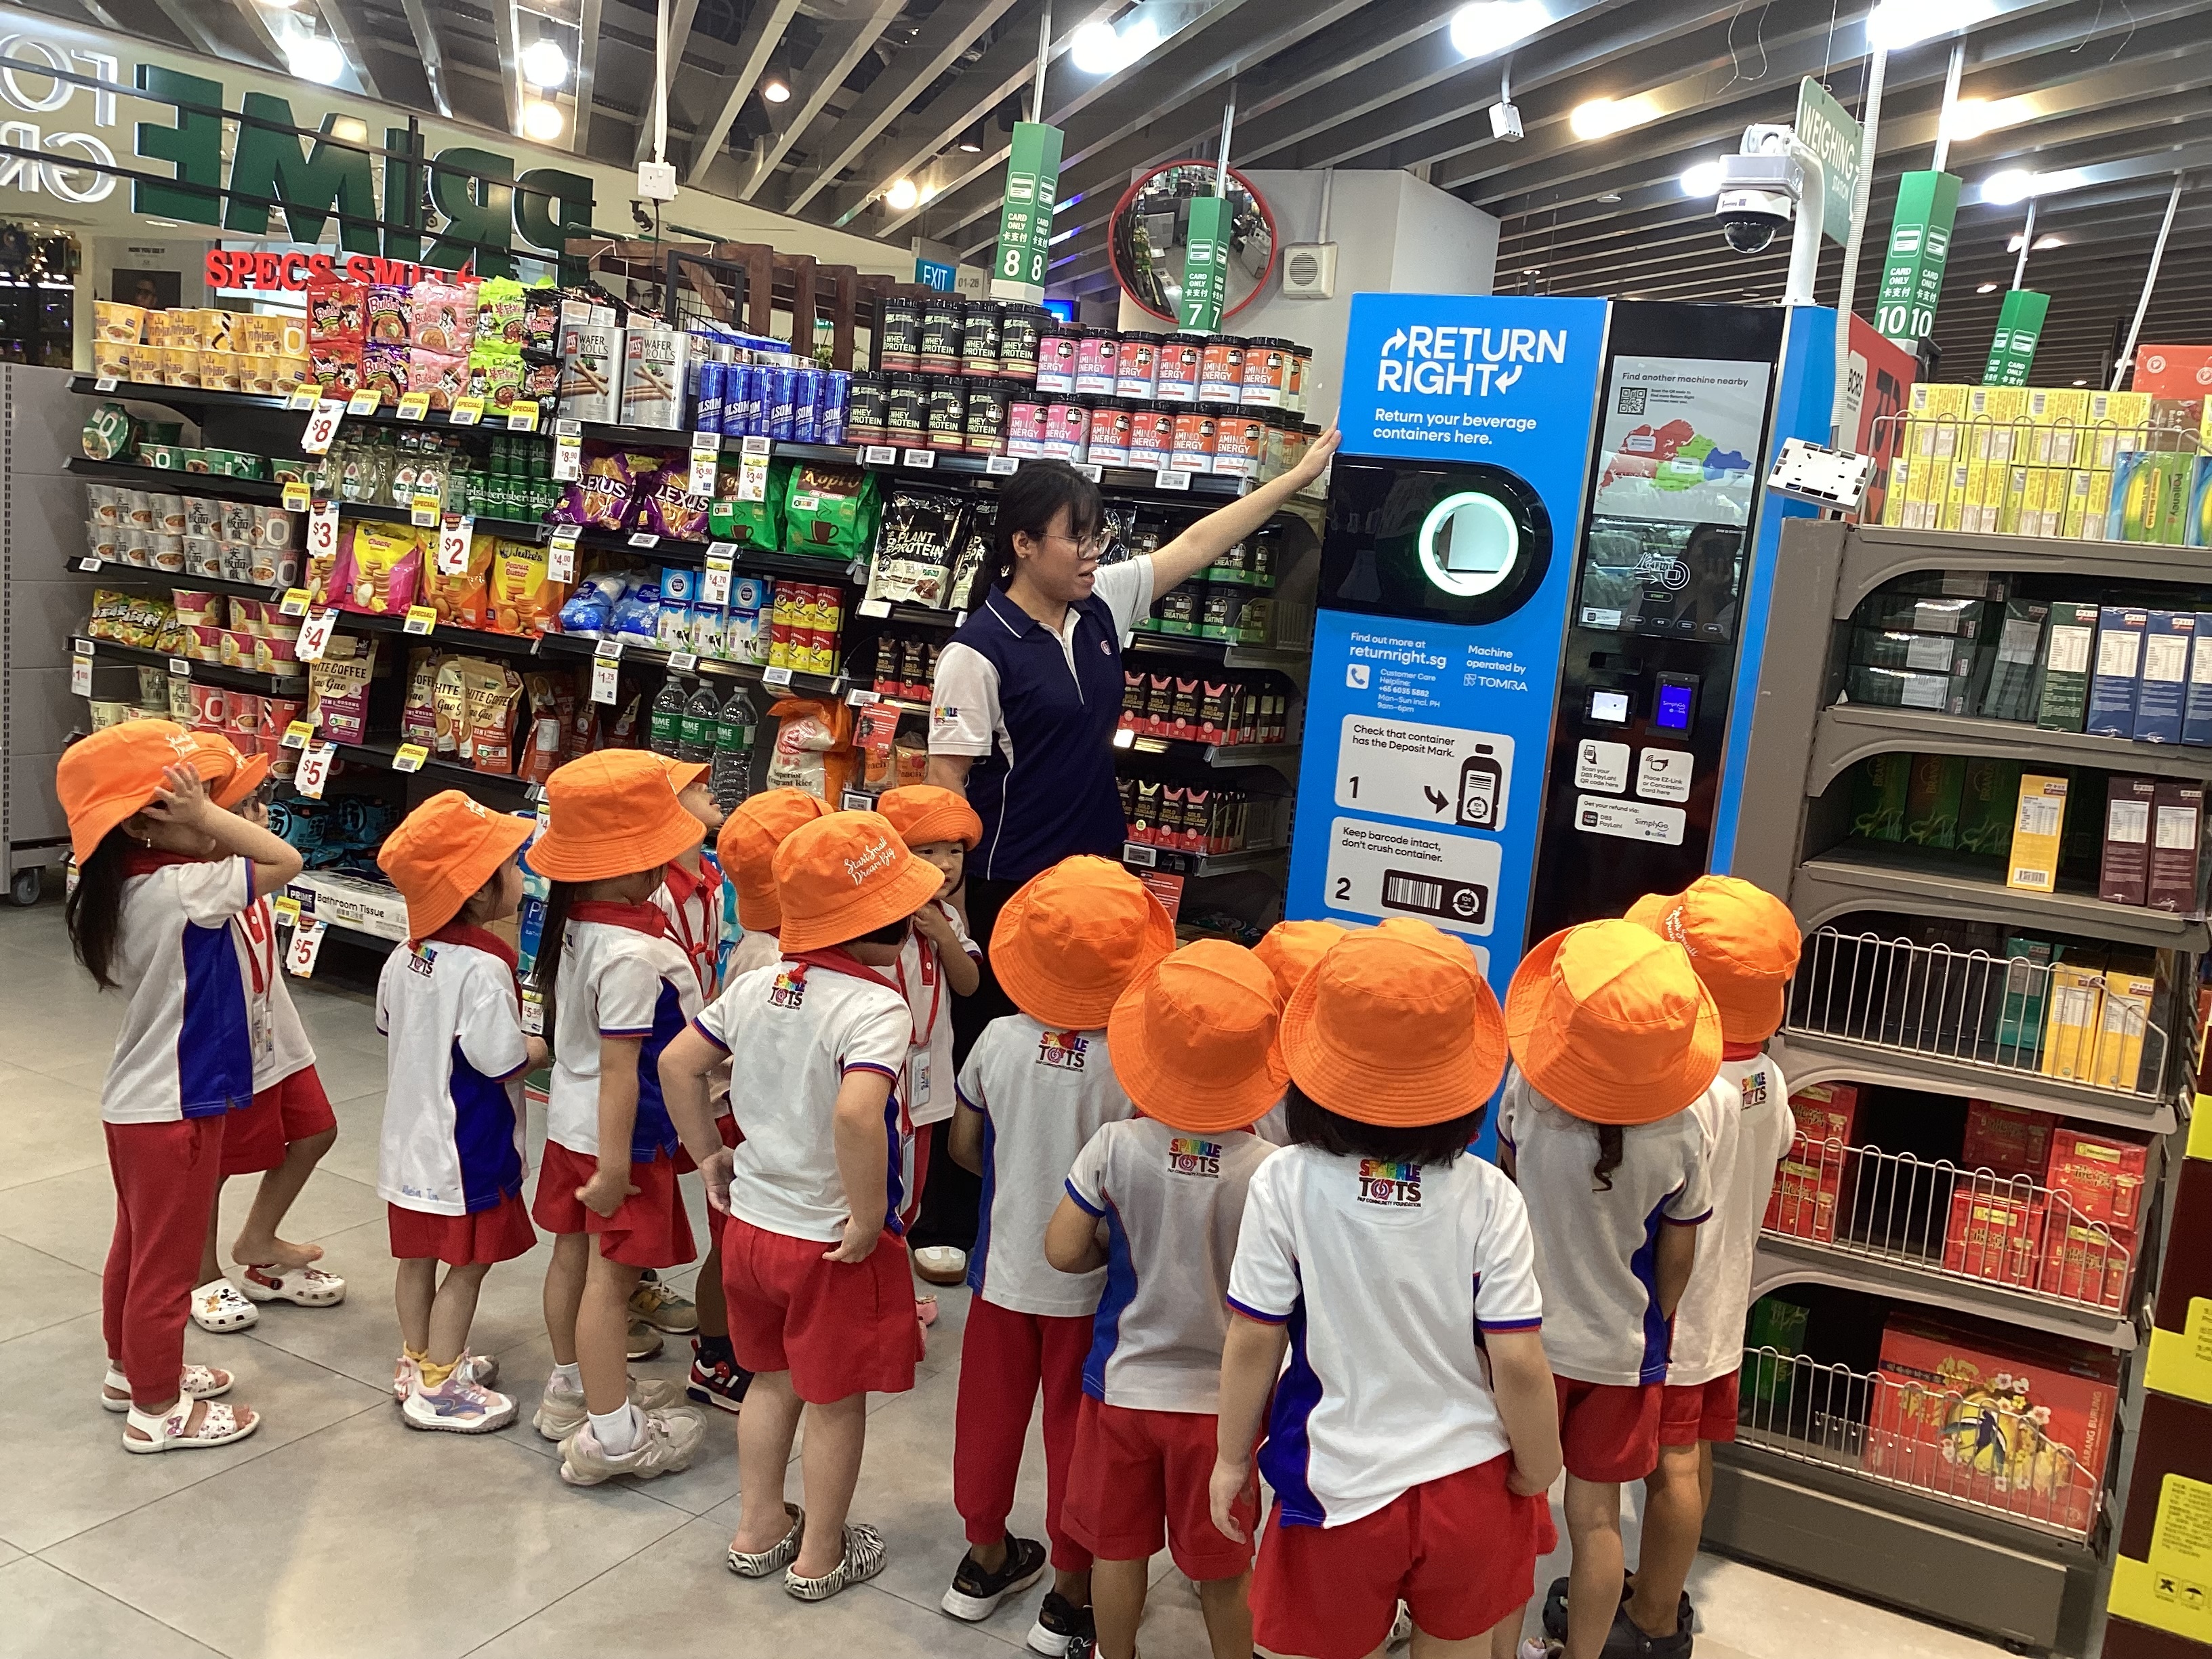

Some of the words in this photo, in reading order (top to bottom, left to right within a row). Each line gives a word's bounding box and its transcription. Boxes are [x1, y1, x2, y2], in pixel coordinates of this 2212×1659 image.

[1802, 101, 1855, 180] WEIGHING
[1007, 213, 1027, 222] CARD
[1036, 216, 1049, 228] CARD
[1007, 221, 1026, 231] ONLY
[1036, 224, 1048, 235] ONLY
[1002, 232, 1028, 243] 卡支付
[1003, 249, 1021, 276] 8
[1031, 255, 1042, 281] 8
[205, 250, 339, 291] SPECS
[922, 265, 947, 291] EXIT
[1189, 272, 1208, 281] CARD
[1889, 267, 1912, 276] CARD
[1923, 269, 1939, 282] CARD
[958, 279, 979, 288] 01-28
[1189, 279, 1206, 288] ONLY
[1889, 275, 1910, 286] ONLY
[1921, 278, 1938, 290] ONLY
[1185, 287, 1208, 298] 卡支付
[1883, 287, 1912, 298] 卡支付
[1916, 288, 1938, 303] 卡支付
[1188, 304, 1205, 327] 7
[1212, 306, 1221, 328] 7
[1878, 306, 1907, 334] 10
[1910, 308, 1933, 337] 10
[579, 334, 605, 346] WAFER
[644, 338, 672, 350] WAFER
[886, 335, 907, 344] WHEY
[925, 337, 945, 346] WHEY
[966, 340, 985, 350] WHEY
[1004, 342, 1023, 350] WHEY
[1407, 325, 1568, 363] RETURN
[580, 344, 609, 355] ROLLS
[646, 347, 676, 360] ROLLS
[886, 342, 916, 353] PROTEIN
[924, 344, 954, 354] PROTEIN
[966, 347, 996, 358] PROTEIN
[1003, 349, 1033, 359] PROTEIN
[2007, 362, 2026, 371] CARD
[2007, 368, 2024, 377] ONLY
[1202, 371, 1232, 381] ENERGY
[1377, 359, 1499, 396] RIGHT
[1642, 374, 1676, 382] another
[1717, 378, 1748, 387] nearby
[1375, 408, 1423, 423] Return
[1427, 413, 1460, 427] your
[1462, 413, 1537, 432] beverage
[312, 419, 332, 442] $8
[1373, 428, 1451, 443] containers
[1454, 430, 1492, 445] here.
[1132, 437, 1161, 447] ENERGY
[575, 474, 628, 499] LEXUS
[655, 483, 710, 512] LEXUS
[313, 522, 331, 548] $3
[897, 531, 936, 544] PLANT
[445, 538, 464, 565] $2
[1214, 559, 1243, 567] CREATINE
[304, 626, 325, 651] $4
[1351, 632, 1370, 642] Find
[1372, 636, 1387, 644] out
[1389, 638, 1414, 647] more
[1415, 640, 1426, 649] at
[1349, 645, 1447, 669] returnright.sg
[1468, 645, 1513, 659] Machine
[331, 663, 366, 678] COFFEE
[1380, 668, 1416, 680] Customer
[1418, 672, 1436, 681] Care
[1467, 659, 1511, 672] operated
[1514, 665, 1526, 675] by
[1477, 676, 1528, 692] TOMRA
[1413, 698, 1428, 706] incl.
[1429, 700, 1440, 708] PH
[1353, 724, 1385, 737] Check
[1387, 729, 1406, 739] that
[1408, 732, 1455, 746] container
[1352, 735, 1370, 745] has
[1372, 738, 1387, 748] the
[1389, 741, 1426, 755] Deposit
[1427, 746, 1455, 758] Mark.
[303, 760, 322, 785] $5
[1349, 776, 1359, 798] 1
[1650, 782, 1684, 791] Concession
[1635, 818, 1668, 829] SimplyGo
[1343, 826, 1367, 839] Keep
[1368, 830, 1408, 845] barcode
[1410, 836, 1441, 852] intact,
[844, 852, 869, 874] Start
[865, 836, 887, 860] Small
[1342, 838, 1366, 849] don't
[1368, 842, 1393, 854] crush
[1395, 845, 1443, 862] container.
[852, 861, 881, 886] Dream
[1335, 877, 1351, 900] 2
[290, 890, 313, 903] PRIME
[317, 894, 357, 912] Bathroom
[360, 903, 384, 918] Tissue
[295, 939, 314, 964] $5
[771, 987, 803, 1006] TOTS
[1038, 1044, 1085, 1068] TOTS
[1169, 1151, 1221, 1174] TOTS
[1359, 1177, 1421, 1202] TOTS
[2082, 1430, 2095, 1467] SARANG
